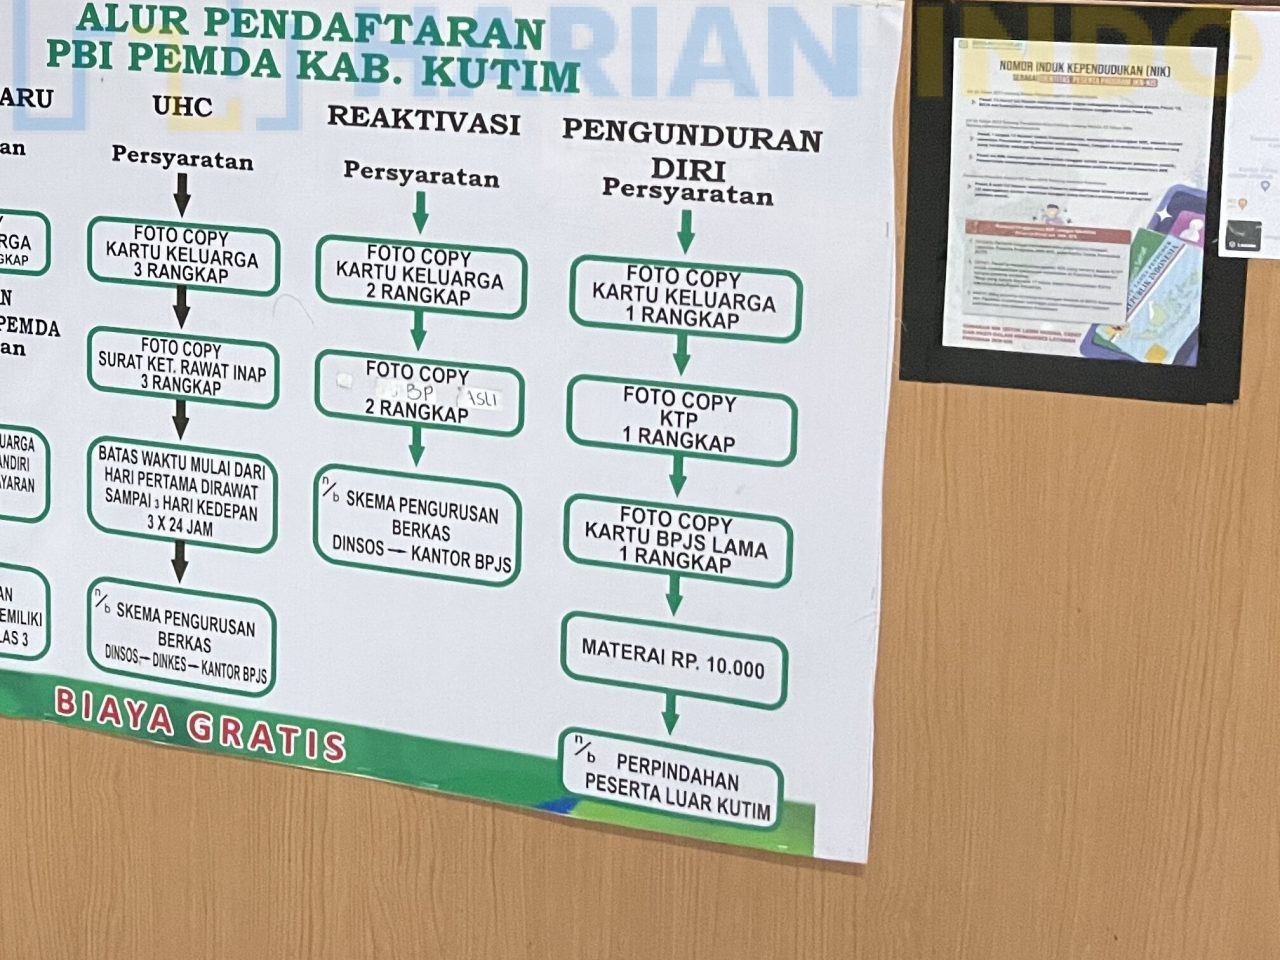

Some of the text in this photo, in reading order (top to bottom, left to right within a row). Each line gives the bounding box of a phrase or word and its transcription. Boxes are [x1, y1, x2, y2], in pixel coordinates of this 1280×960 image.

[76, 2, 546, 50] ALUR PENDAFTARAN
[47, 39, 580, 93] PBI PEMDA KAB. KUTIM
[1000, 61, 1170, 77] NOMOR INDUK KEPENDUDUKAN (NIK)
[152, 95, 213, 117] UHC
[327, 105, 521, 136] REAKTIVASI
[562, 118, 823, 153] PENGUNDURAN
[112, 144, 254, 171] Persyaratan
[651, 157, 726, 183] DIRI
[344, 160, 500, 188] Persyaratan
[602, 176, 774, 206] Persyaratan
[99, 351, 266, 383] SURAT KET. RAWAT INAP
[366, 399, 469, 423] 2 RANGKAP
[661, 410, 698, 428] KTP
[98, 445, 265, 481] BATAS WAKTU MULAI DARI
[104, 467, 258, 501] HARI PERTAMA DIRAWAT
[105, 488, 258, 522] SAMPAI 3 HARI KEDEPAN
[147, 515, 213, 537] 3 X 24 JAM
[585, 521, 768, 559] KARTU BPJS LAMA
[333, 534, 512, 573] DINSOS KANTOR BPJS
[117, 602, 255, 638] SKEMA PENGURUSAN
[22, 633, 28, 647] 3
[158, 631, 212, 653] BERKAS
[153, 652, 186, 671] DINKES
[201, 660, 240, 681] KANTOR
[243, 666, 267, 684] BPJS
[582, 638, 765, 680] MATERAI RP. 10.000
[54, 686, 346, 763] BIAYA GRATIS
[617, 753, 739, 792] PERPINDAHAN
[585, 772, 771, 822] PESERTA LUAR KUTIM
